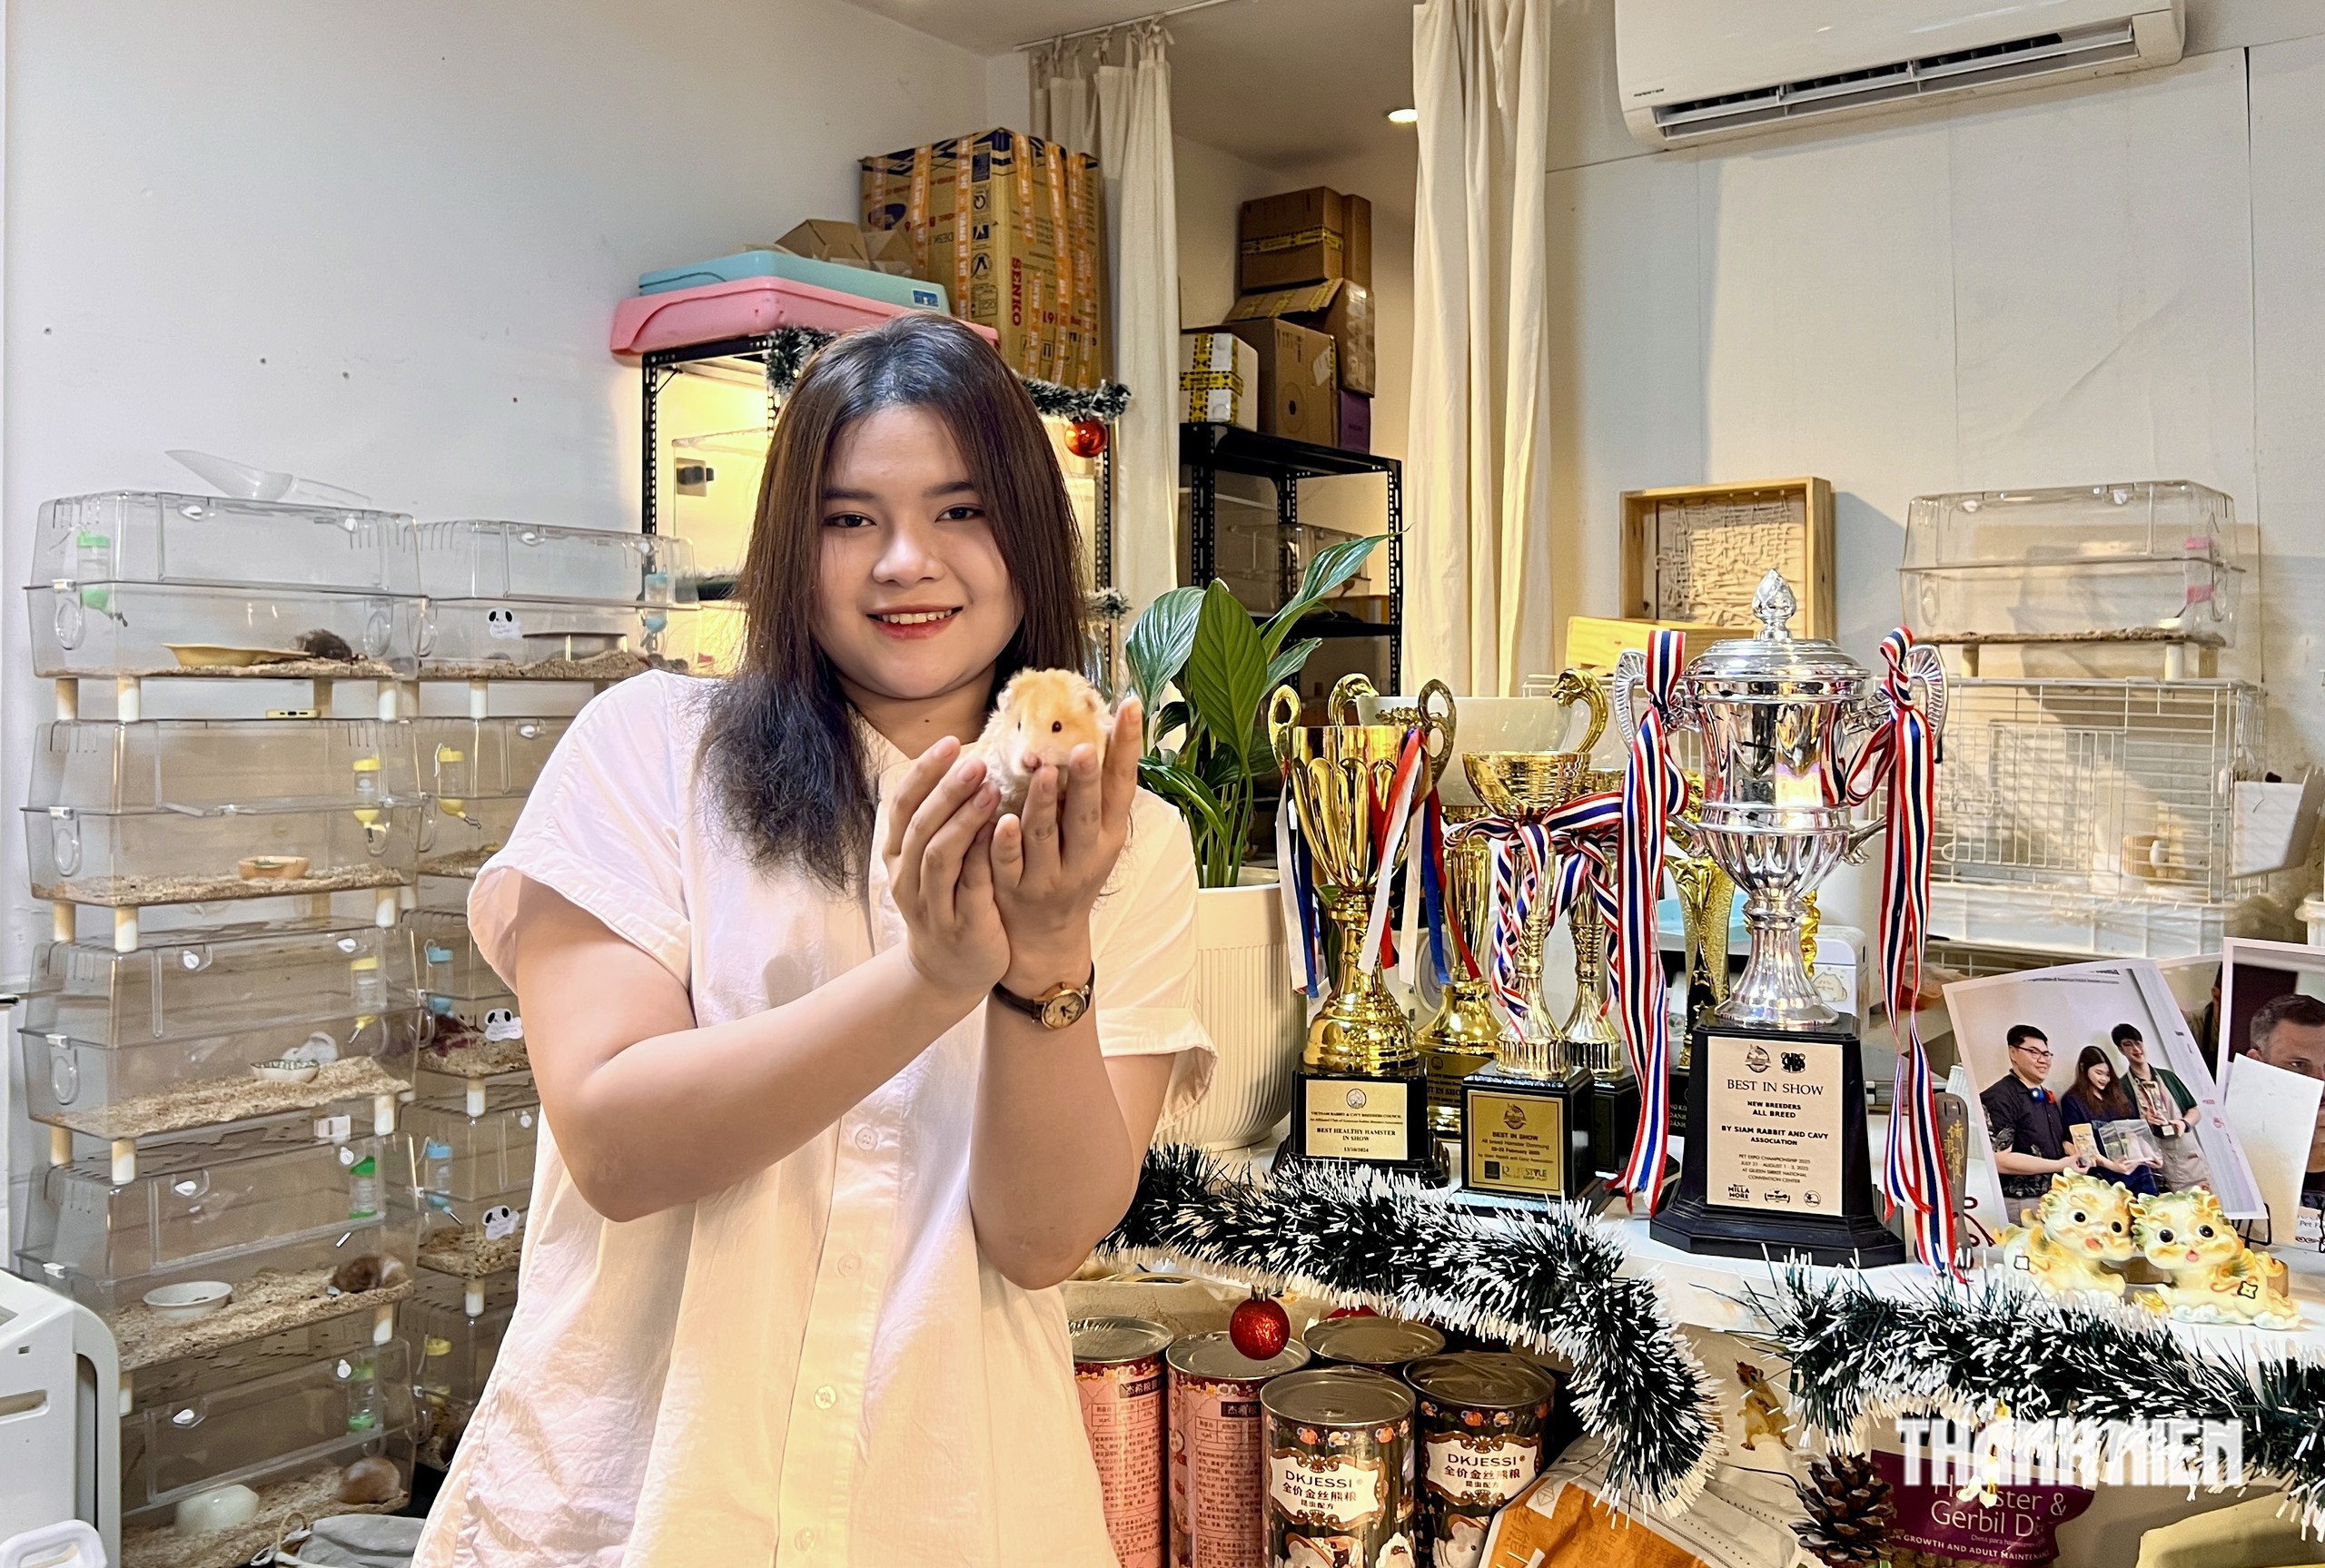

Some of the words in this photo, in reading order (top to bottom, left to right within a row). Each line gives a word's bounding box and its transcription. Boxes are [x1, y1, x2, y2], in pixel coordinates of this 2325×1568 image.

[1011, 256, 1023, 327] SENKO
[1726, 1079, 1757, 1090] BEST
[1763, 1081, 1777, 1092] IN
[1782, 1082, 1824, 1096] SHOW
[1765, 1101, 1802, 1110] BREEDERS
[1752, 1109, 1767, 1117] ALL
[1769, 1110, 1796, 1119] BREED
[1750, 1137, 1797, 1146] ASSOCIATION
[1756, 1128, 1786, 1136] RABBIT
[1807, 1131, 1828, 1139] CAVY
[1727, 1186, 1750, 1194] MILLA
[1448, 1453, 1517, 1467] DKJESSI
[1285, 1469, 1352, 1488] DKJESSI
[1444, 1464, 1520, 1480] 全价金丝熊粮
[1282, 1482, 1357, 1502] 全价金丝熊粮
[2050, 1492, 2067, 1516] &
[1931, 1499, 2005, 1533] Gerbil
[1903, 1533, 1944, 1549] GROWTH
[1946, 1543, 1967, 1553] AND
[1968, 1547, 1998, 1558] ADULT
